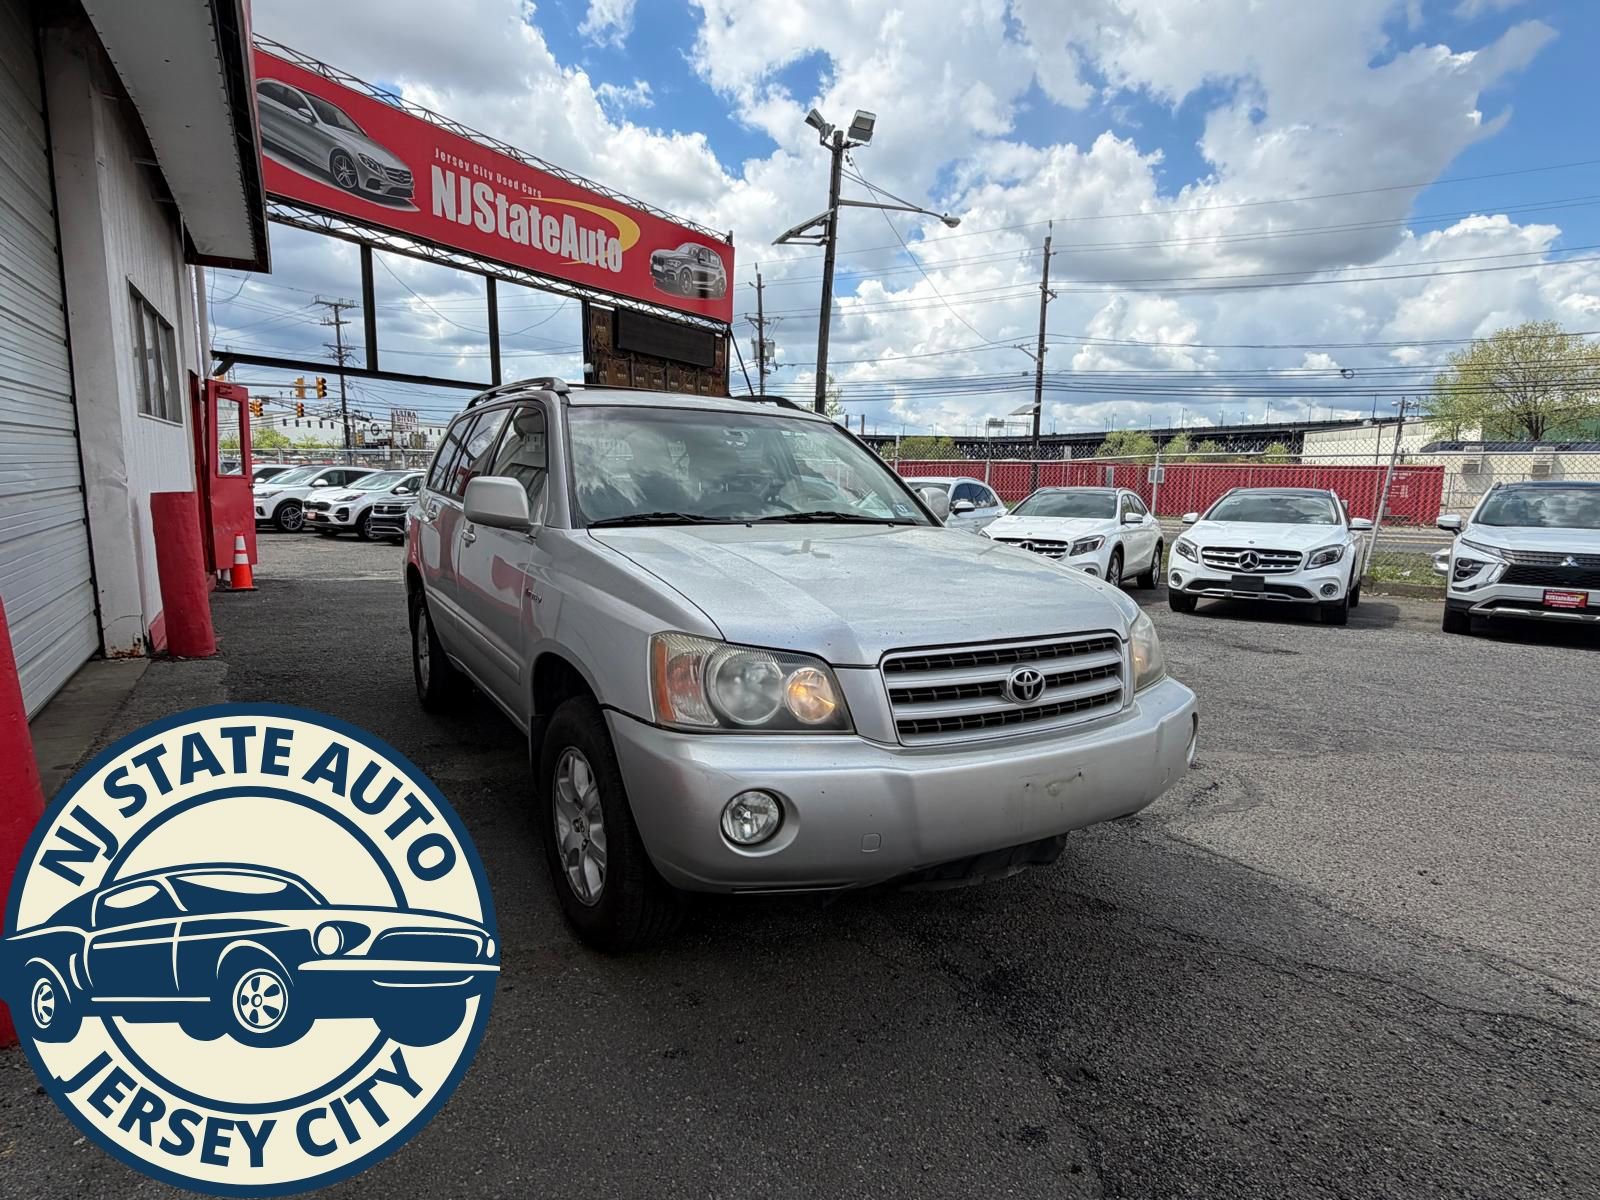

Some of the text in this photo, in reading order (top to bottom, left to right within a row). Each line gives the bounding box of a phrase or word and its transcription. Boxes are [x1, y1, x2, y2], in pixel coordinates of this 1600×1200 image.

[435, 147, 542, 198] Jersey City Used Cars
[431, 165, 623, 273] NJStateAuto
